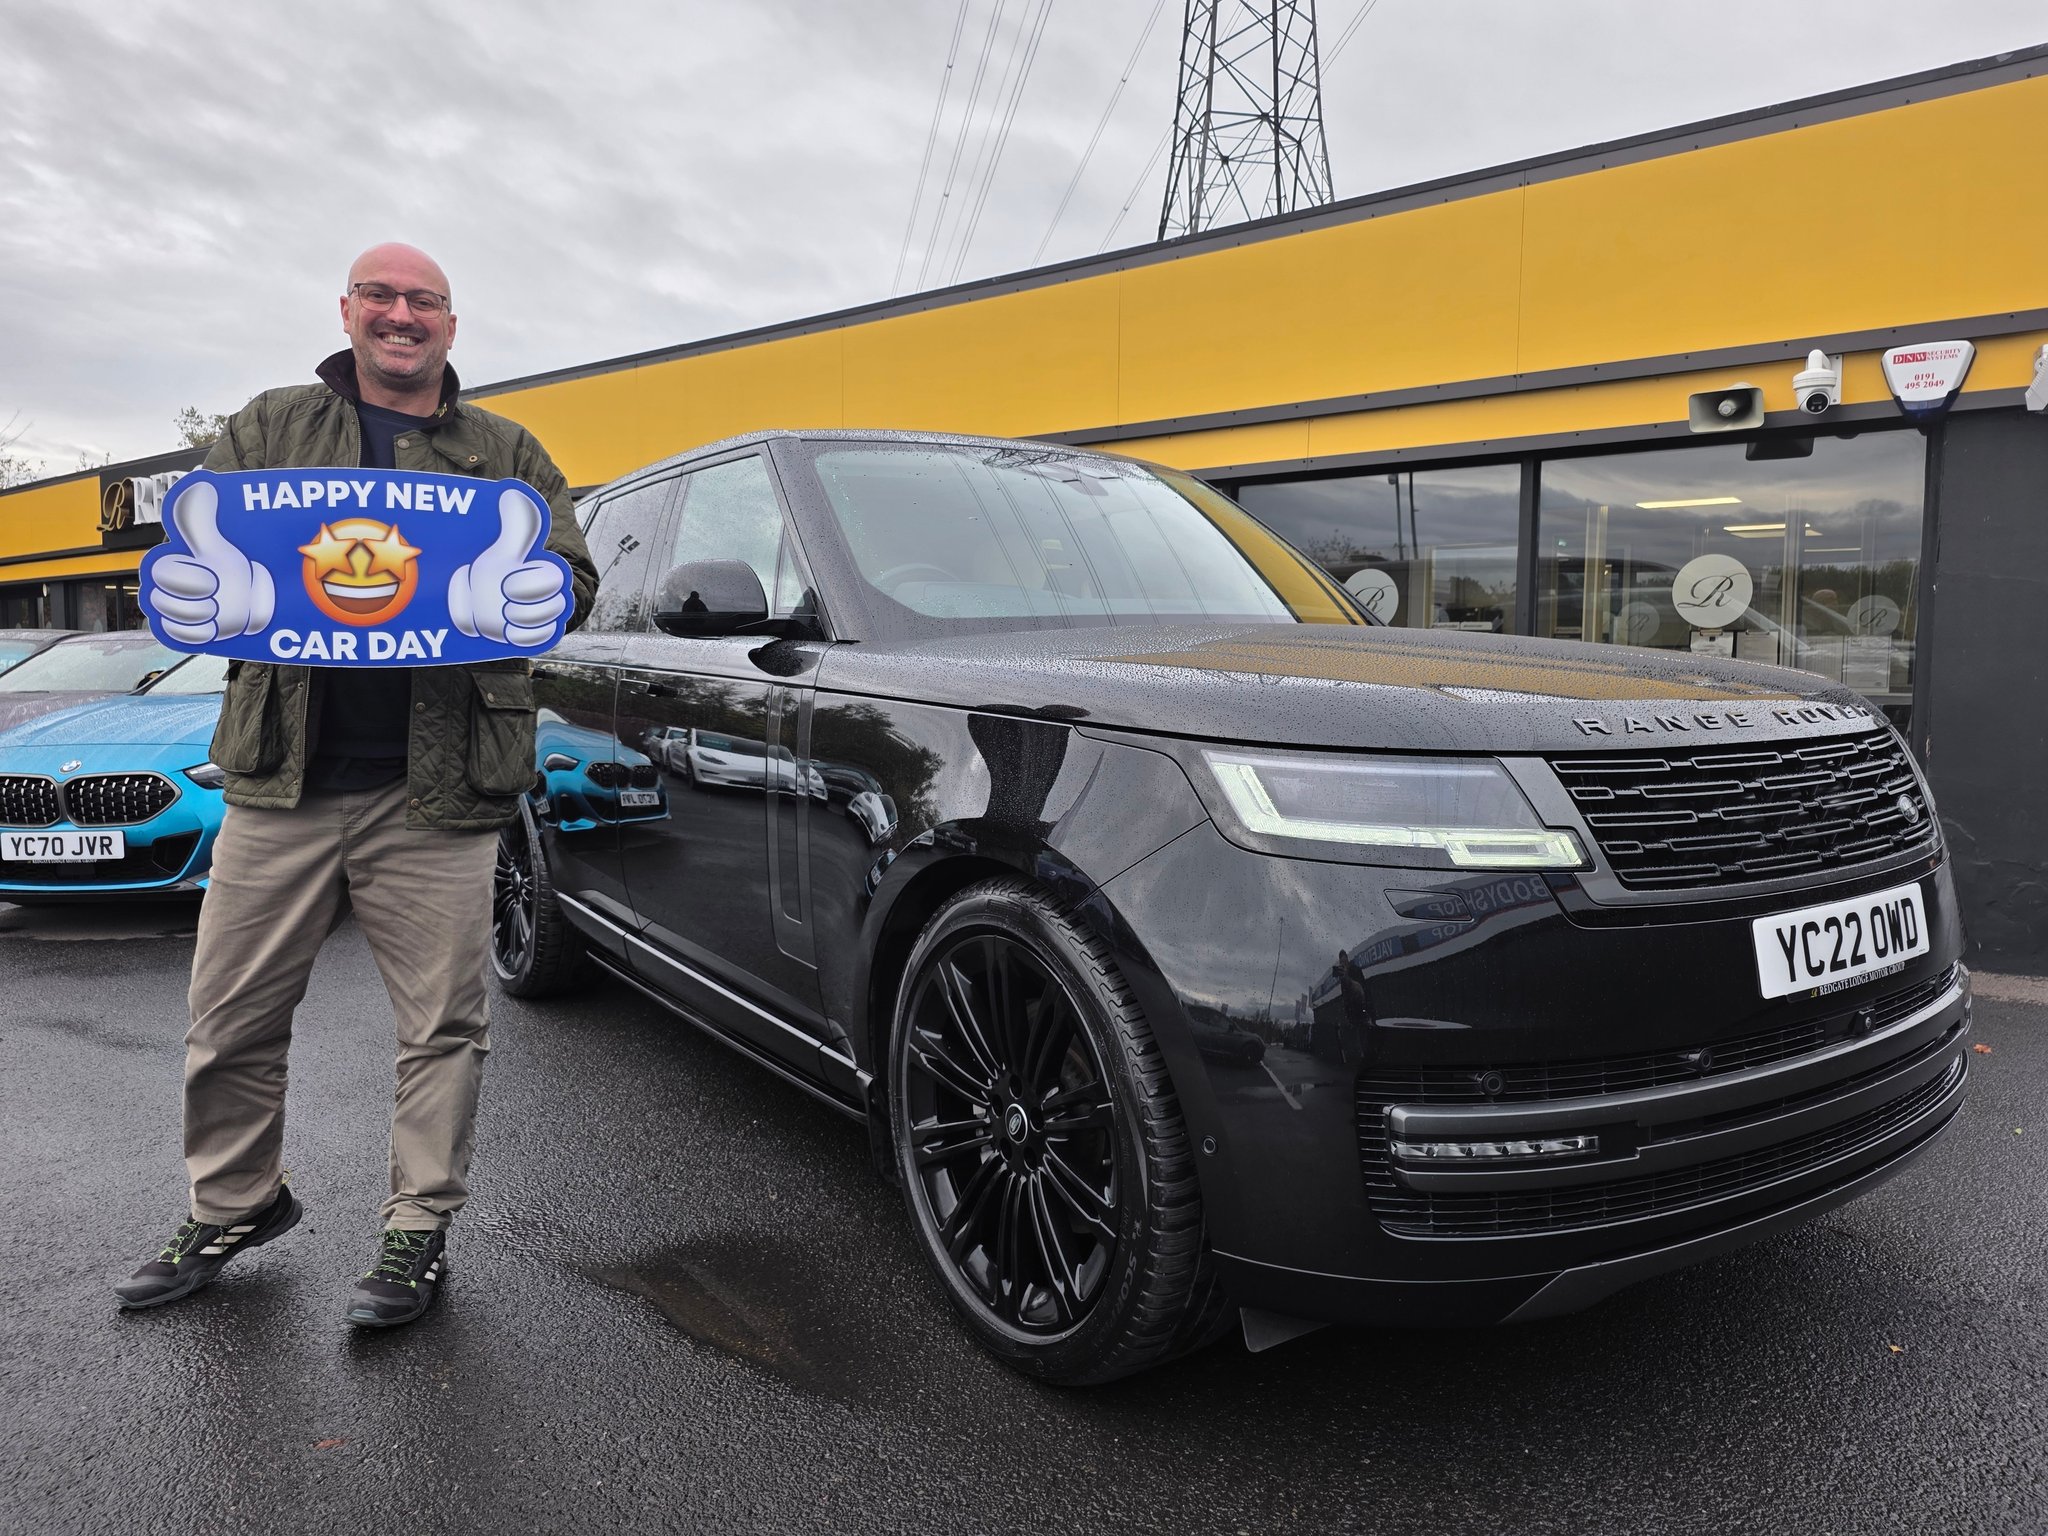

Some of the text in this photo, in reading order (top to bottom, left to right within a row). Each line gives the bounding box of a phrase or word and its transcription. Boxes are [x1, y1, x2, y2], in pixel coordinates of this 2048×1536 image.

[1893, 352, 1927, 364] DNW
[1904, 379, 1945, 390] 495 2049
[1914, 372, 1935, 381] 0191
[243, 480, 476, 515] HAPPY NEW
[1677, 572, 1749, 609] R
[270, 628, 449, 661] CAR DAY
[1573, 704, 1872, 736] RANGE ROVER
[11, 835, 113, 857] YC70 JVR
[1776, 897, 1919, 983] YC22 OWD
[1819, 979, 1850, 996] REDGATE
[1849, 972, 1870, 987] LODGE
[1869, 967, 1890, 982] MOTOR
[1888, 961, 1905, 975] GROUP
